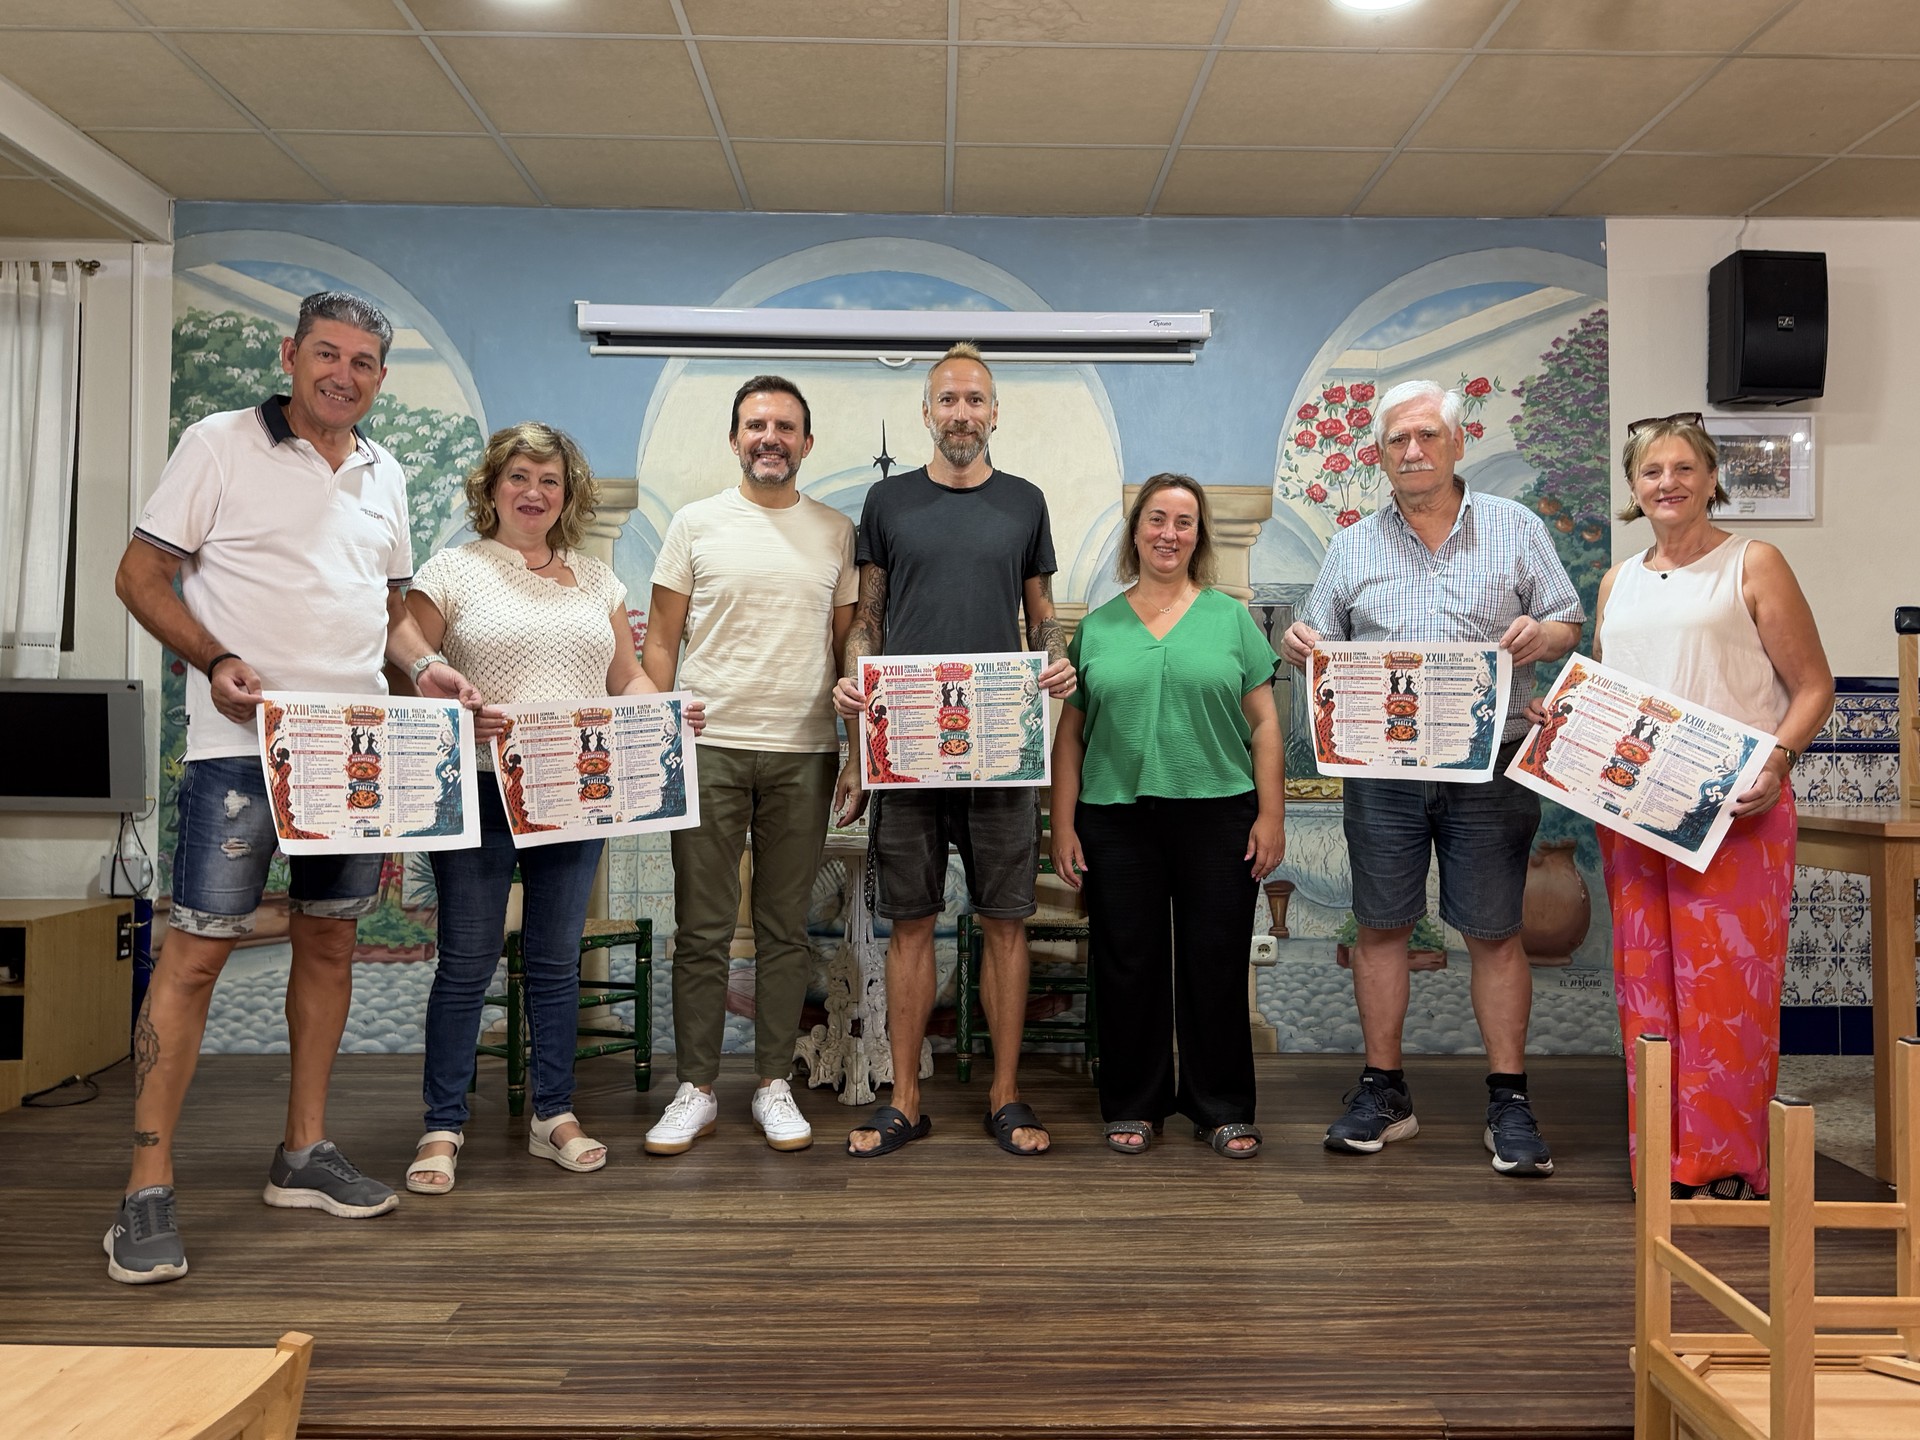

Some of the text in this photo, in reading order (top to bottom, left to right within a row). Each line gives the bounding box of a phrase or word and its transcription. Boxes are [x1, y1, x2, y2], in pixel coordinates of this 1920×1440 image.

[1332, 652, 1352, 662] XXIII
[883, 665, 903, 676] XXIII
[1589, 674, 1612, 689] XXIII
[286, 704, 309, 716] XXIII
[517, 713, 539, 725] XXIII
